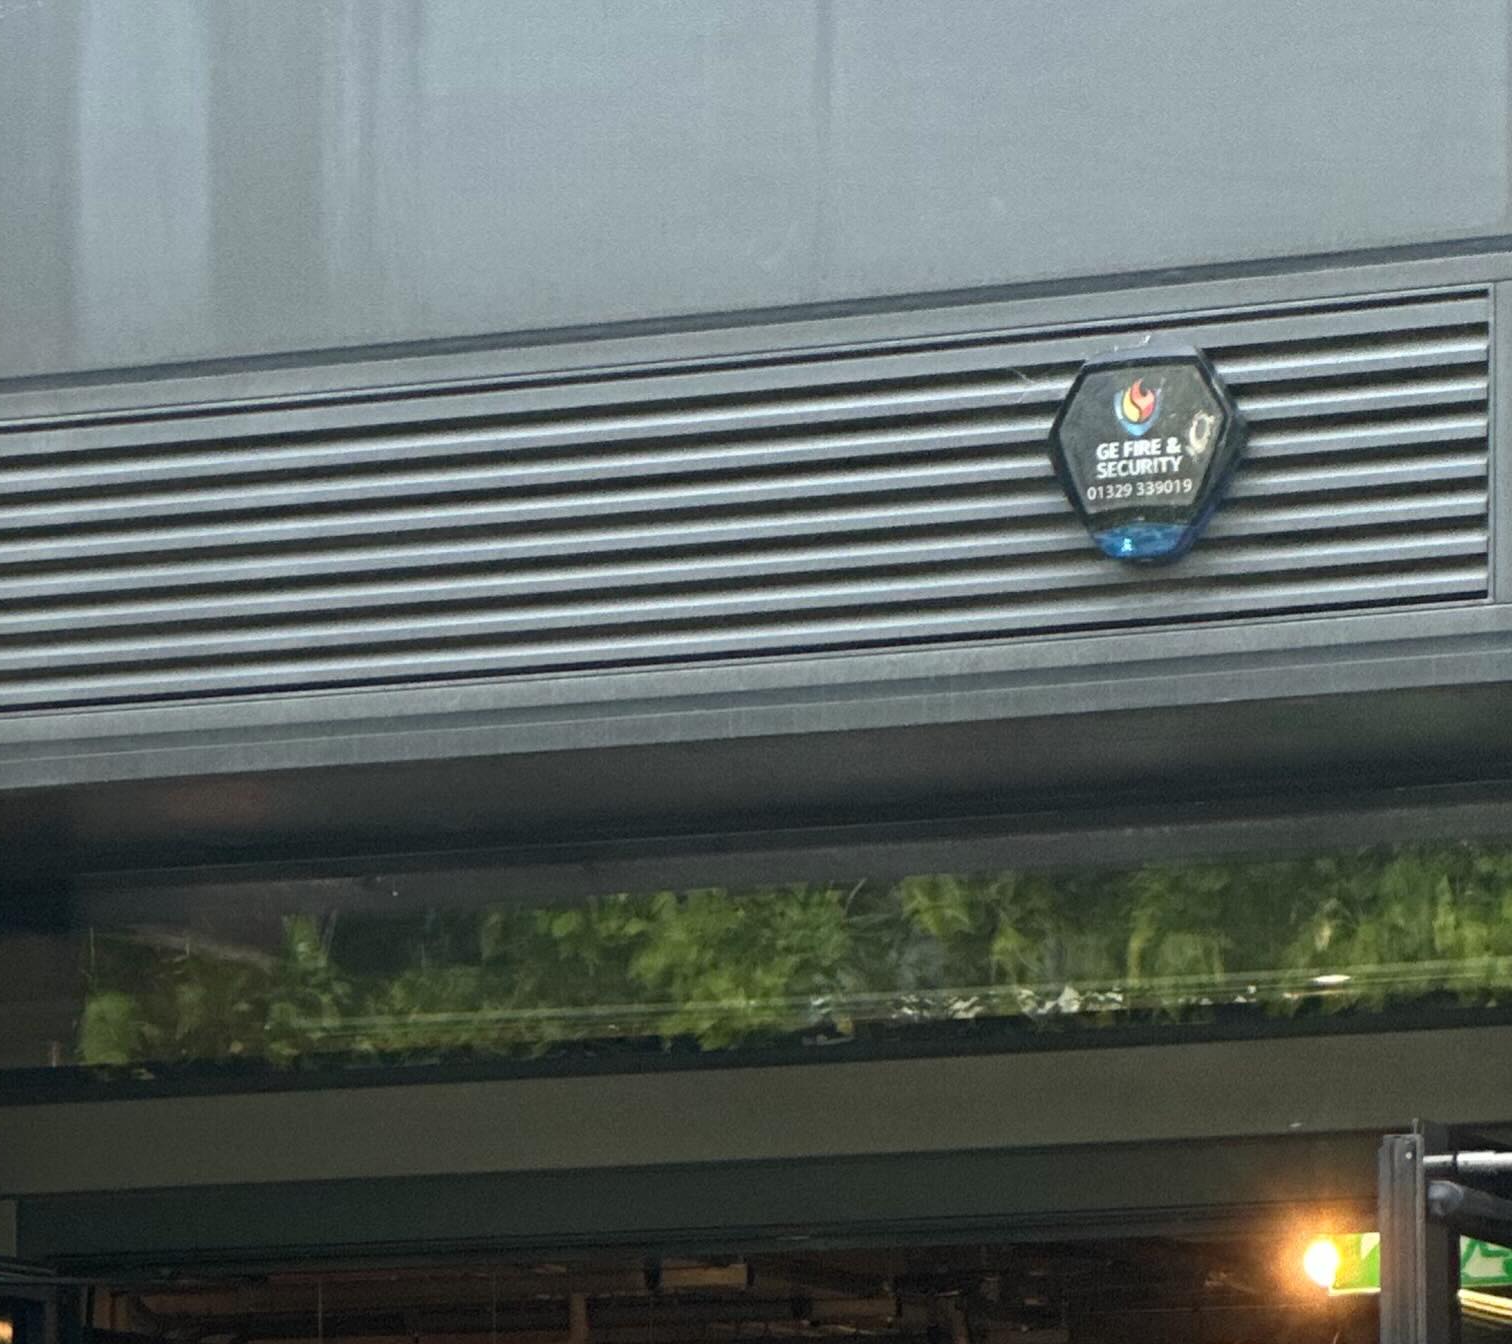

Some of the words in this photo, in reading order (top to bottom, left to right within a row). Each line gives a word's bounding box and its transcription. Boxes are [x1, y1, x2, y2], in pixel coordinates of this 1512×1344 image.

[1096, 442, 1119, 460] GE
[1123, 439, 1161, 459] FIRE
[1165, 437, 1182, 454] &
[1096, 456, 1183, 479] SECURITY
[1087, 484, 1133, 500] 01329
[1136, 478, 1193, 497] 339019
